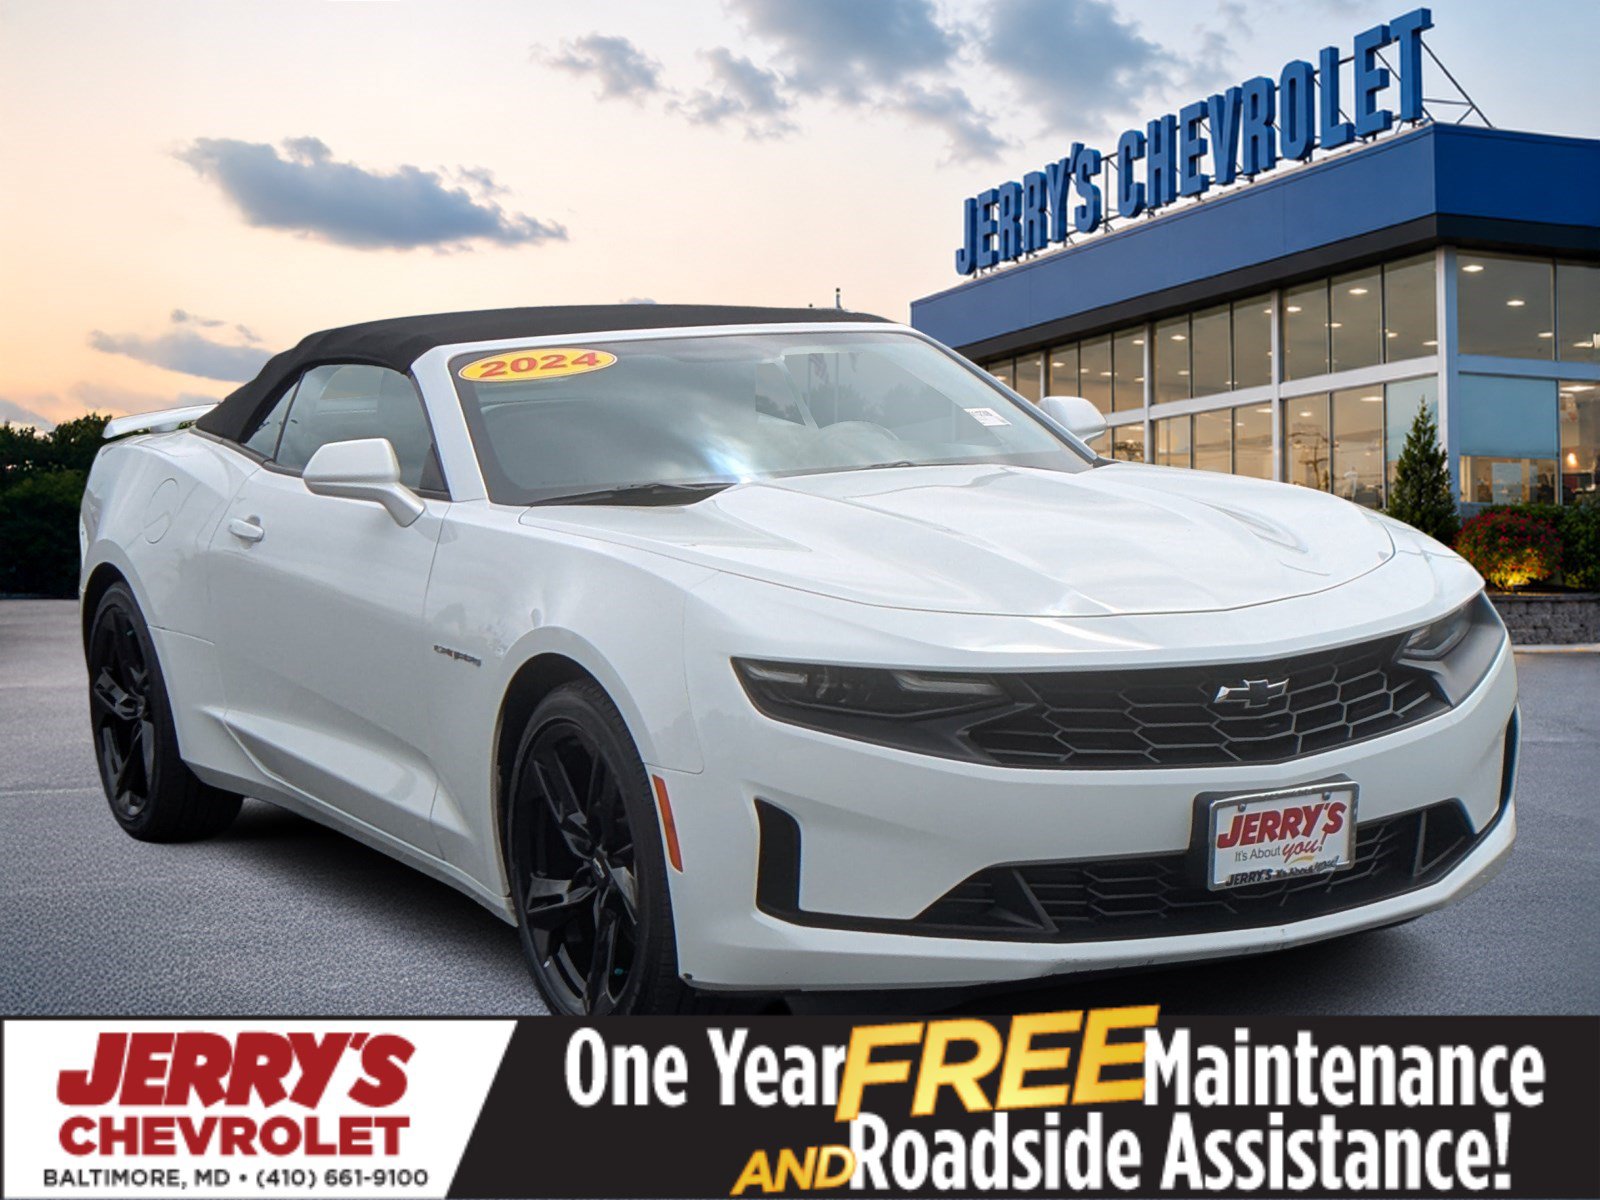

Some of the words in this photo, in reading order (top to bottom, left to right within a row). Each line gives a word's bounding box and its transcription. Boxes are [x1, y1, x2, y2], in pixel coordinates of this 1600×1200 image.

[956, 143, 1102, 276] JERRY'S
[1117, 8, 1434, 219] CHEVROLET
[479, 352, 600, 378] 2024
[1217, 801, 1347, 849] JERRY'S
[1235, 852, 1248, 862] It's
[1250, 846, 1280, 859] About
[1282, 832, 1328, 863] you!
[1225, 868, 1273, 887] JERRY'S
